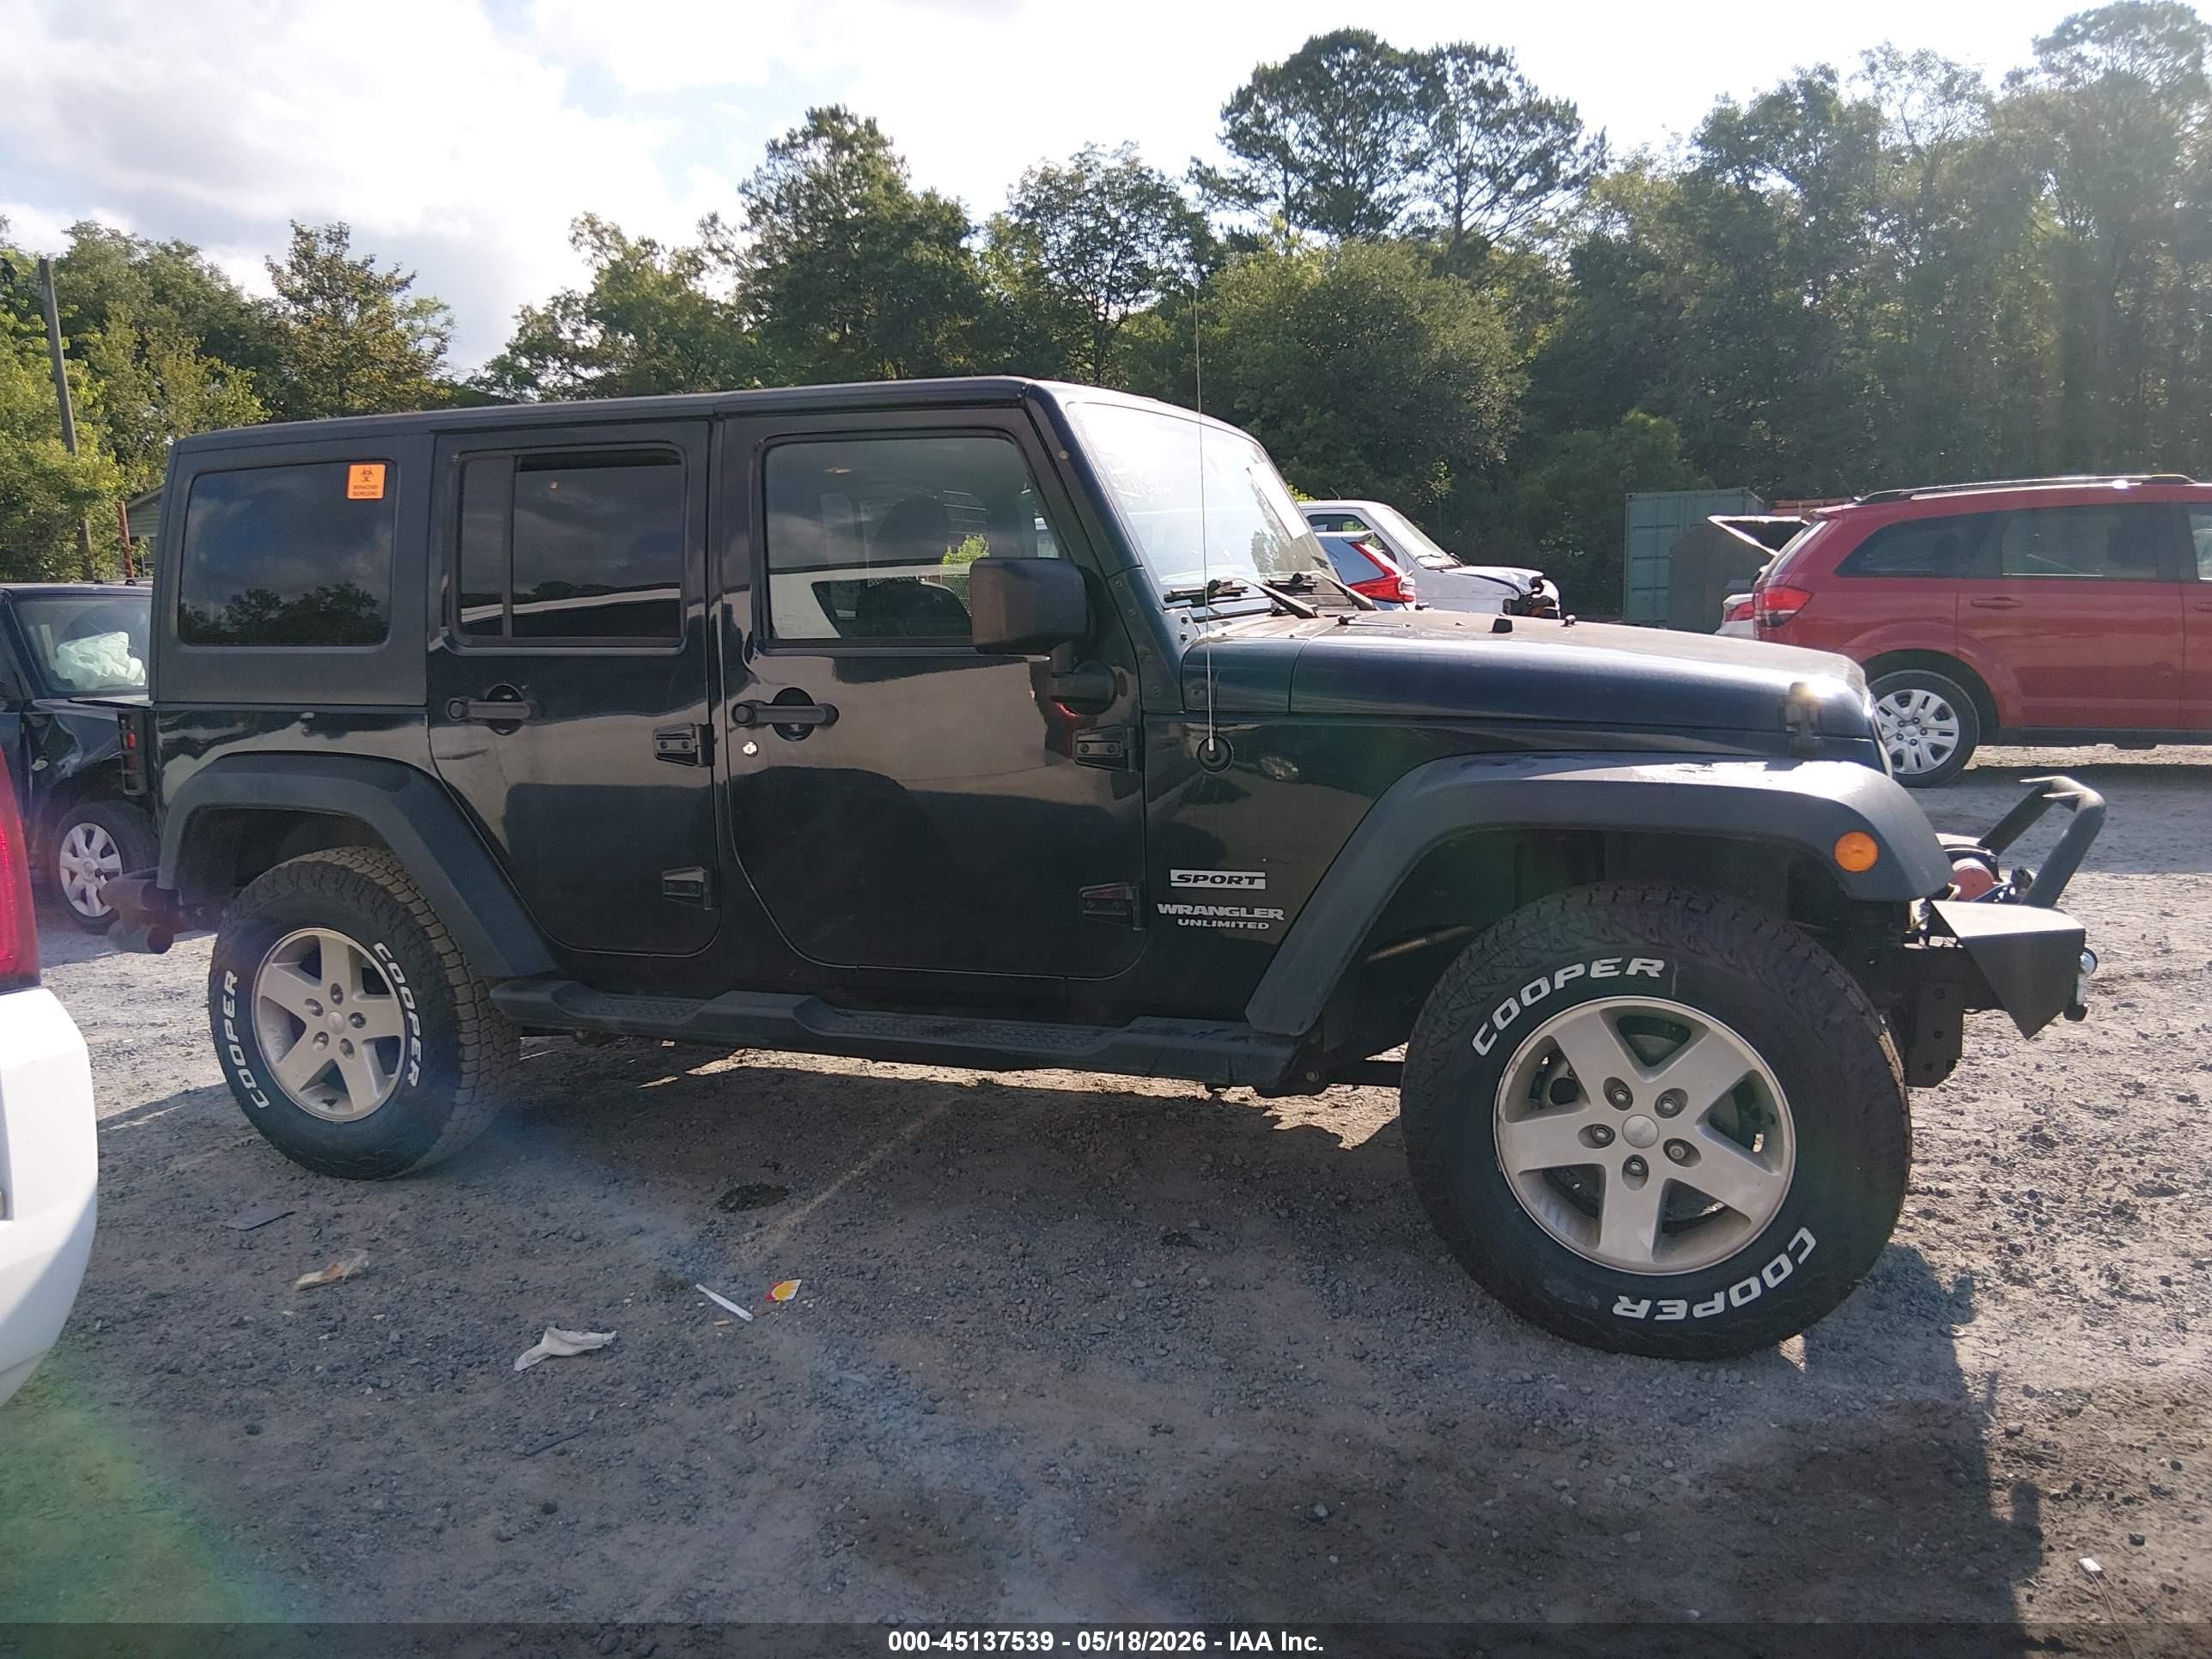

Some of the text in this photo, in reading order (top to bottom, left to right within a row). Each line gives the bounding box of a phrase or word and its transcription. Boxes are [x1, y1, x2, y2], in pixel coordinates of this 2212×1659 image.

[1157, 903, 1285, 921] WRANGLER
[1176, 873, 1257, 886] SPORT
[1177, 918, 1270, 930] UNLIMITED
[223, 970, 270, 1109] COOPER
[374, 942, 422, 1087] COOPER
[1472, 956, 1665, 1057] COOPER
[1612, 1226, 1817, 1321] COOPER
